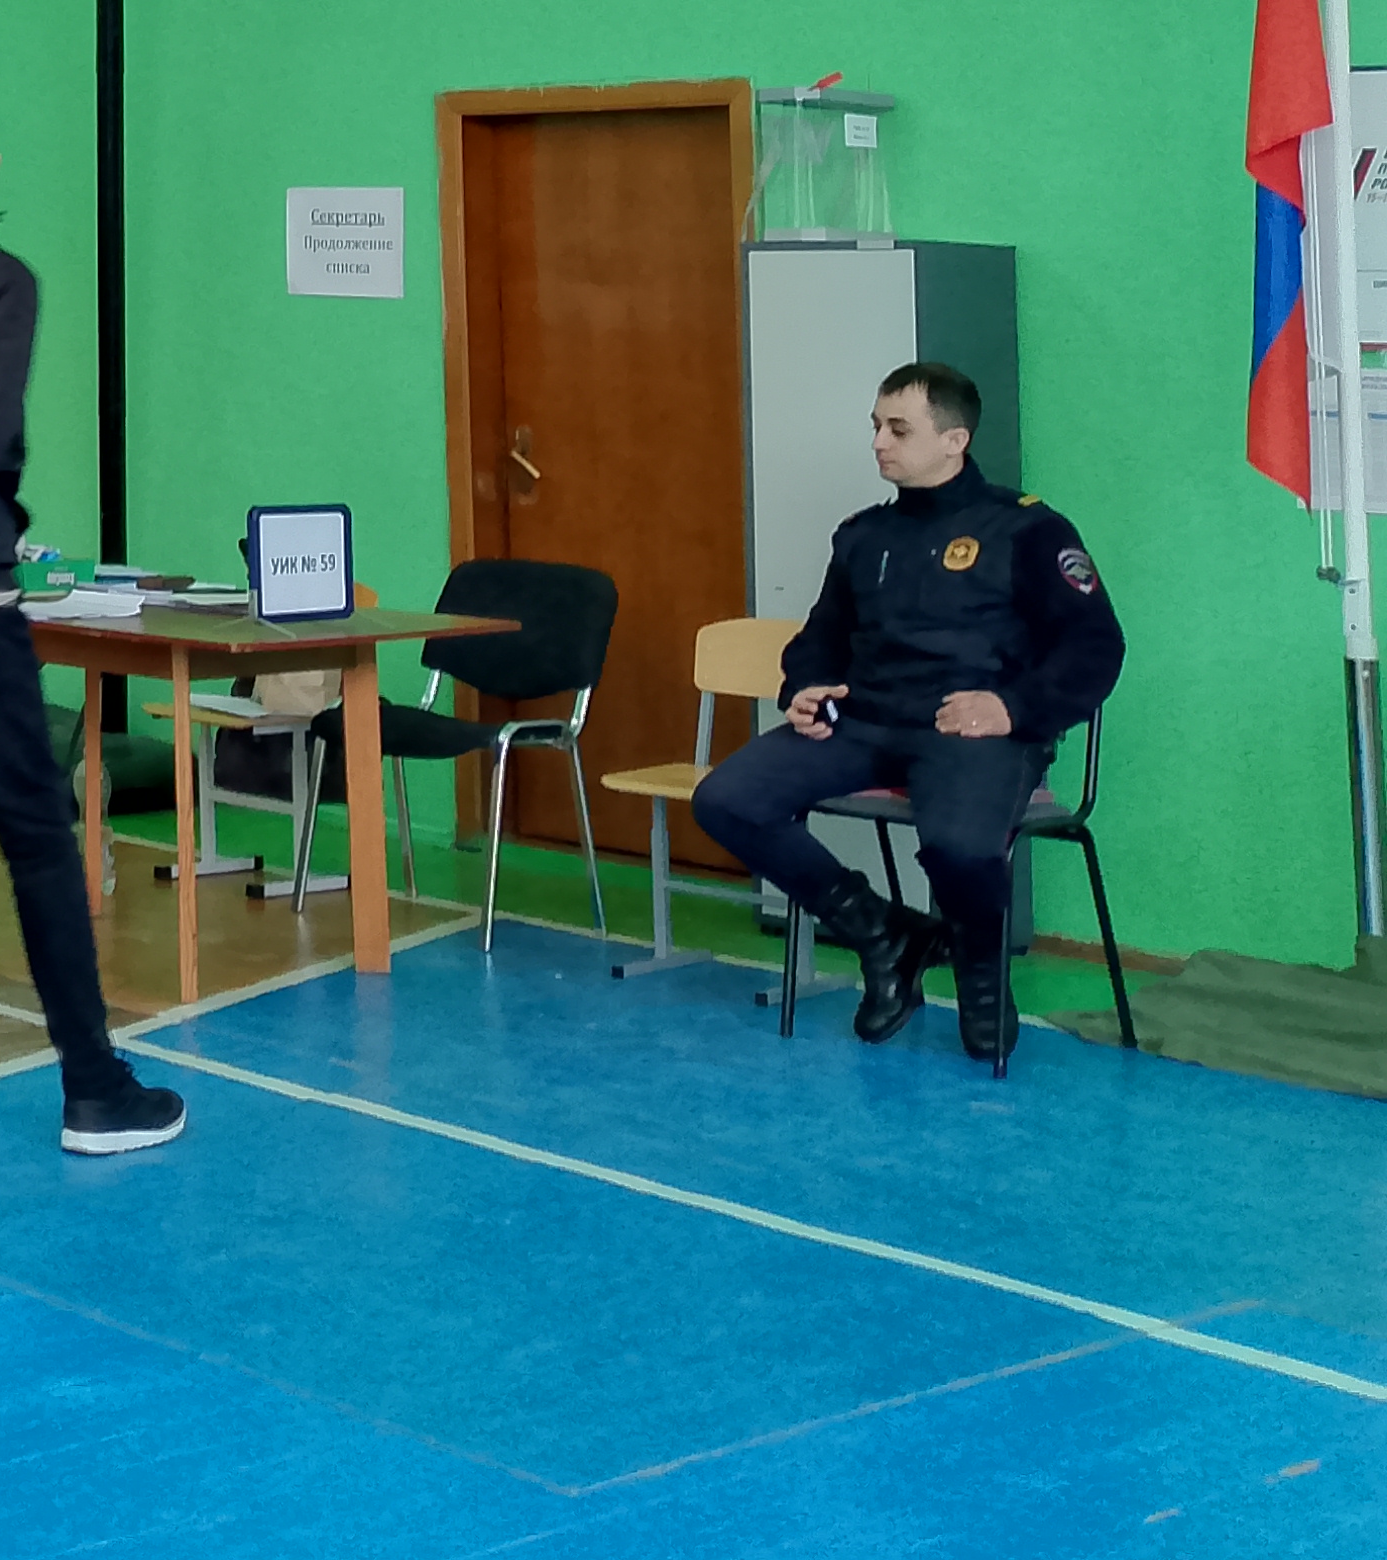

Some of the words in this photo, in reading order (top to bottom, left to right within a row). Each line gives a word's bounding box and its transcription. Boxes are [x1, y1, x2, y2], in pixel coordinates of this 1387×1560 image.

[311, 208, 385, 227] Секретарь
[304, 235, 393, 253] Продолжение
[326, 262, 370, 274] списка
[271, 556, 298, 575] УИК
[301, 555, 316, 573] №
[320, 554, 336, 571] 59
